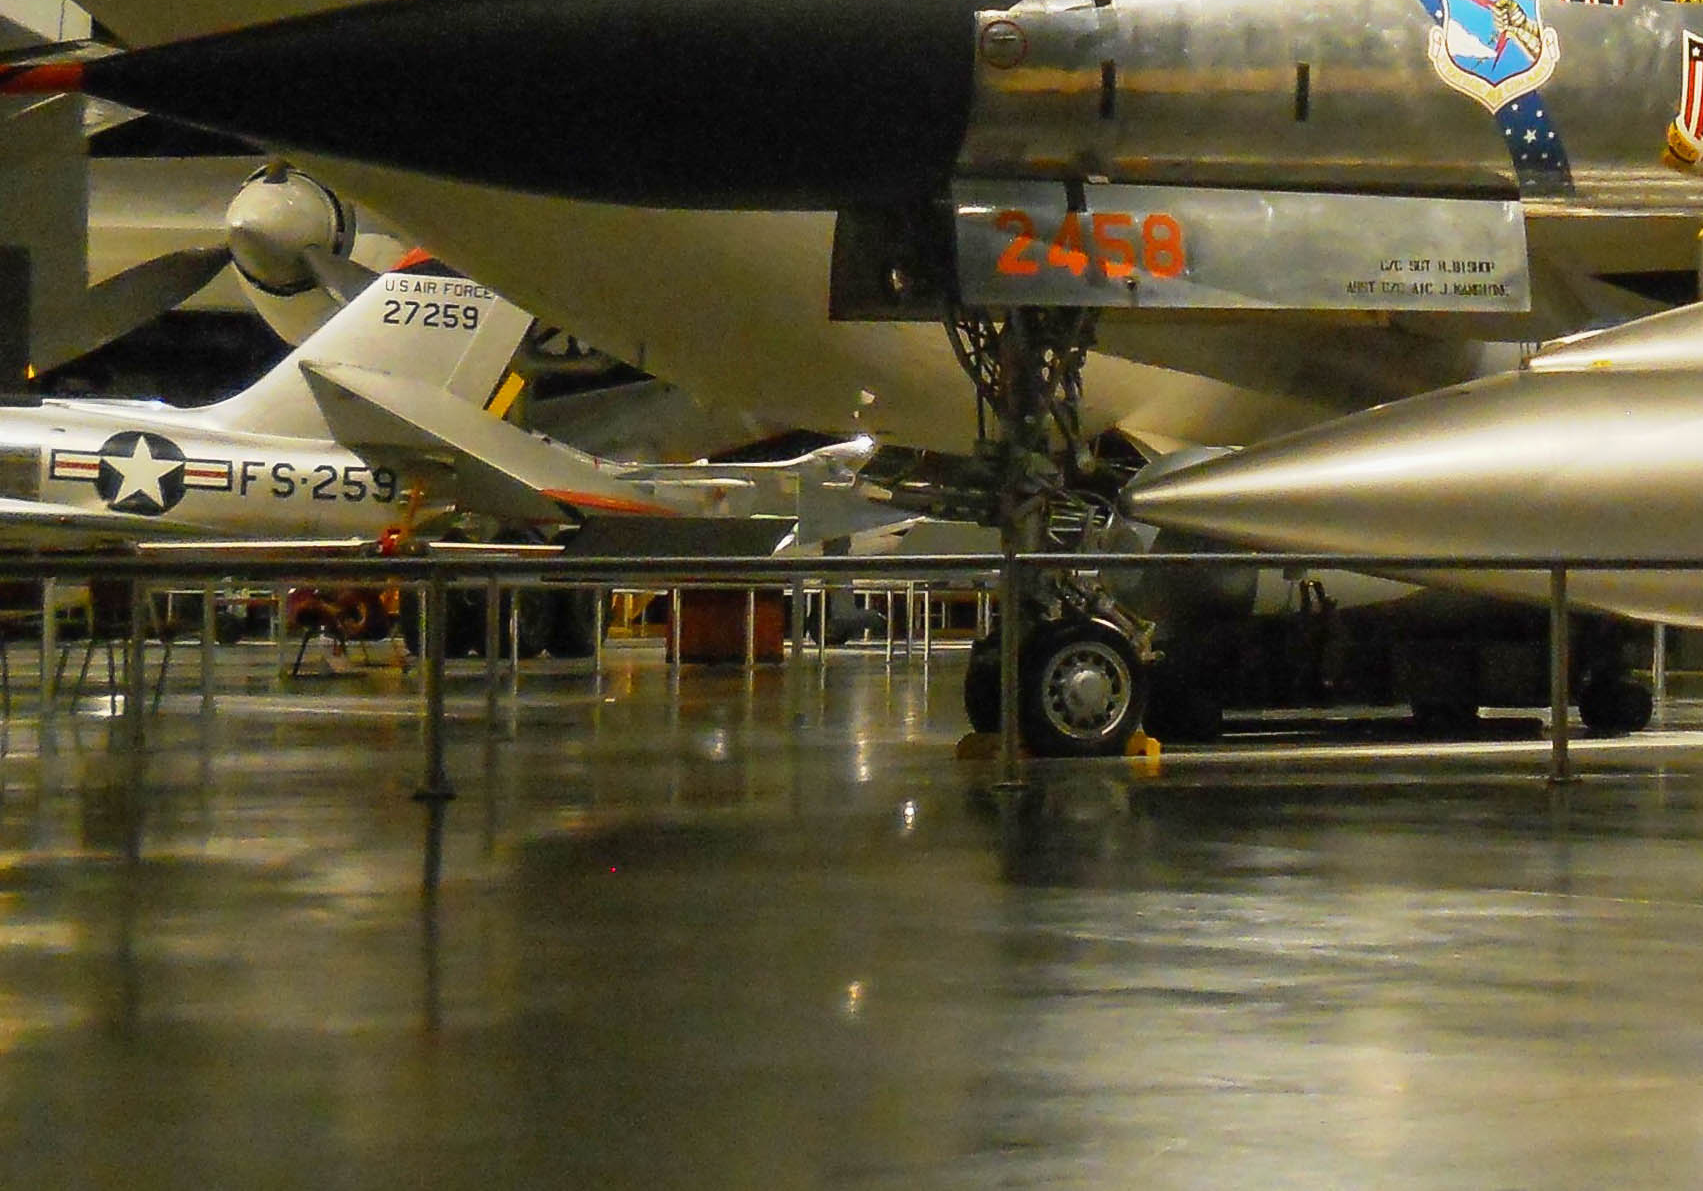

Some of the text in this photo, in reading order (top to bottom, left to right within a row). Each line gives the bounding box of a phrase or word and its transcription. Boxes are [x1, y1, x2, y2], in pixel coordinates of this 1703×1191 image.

[993, 210, 1186, 278] 2458
[414, 281, 437, 293] AIR
[443, 284, 493, 299] FORCE
[383, 299, 479, 330] 27259
